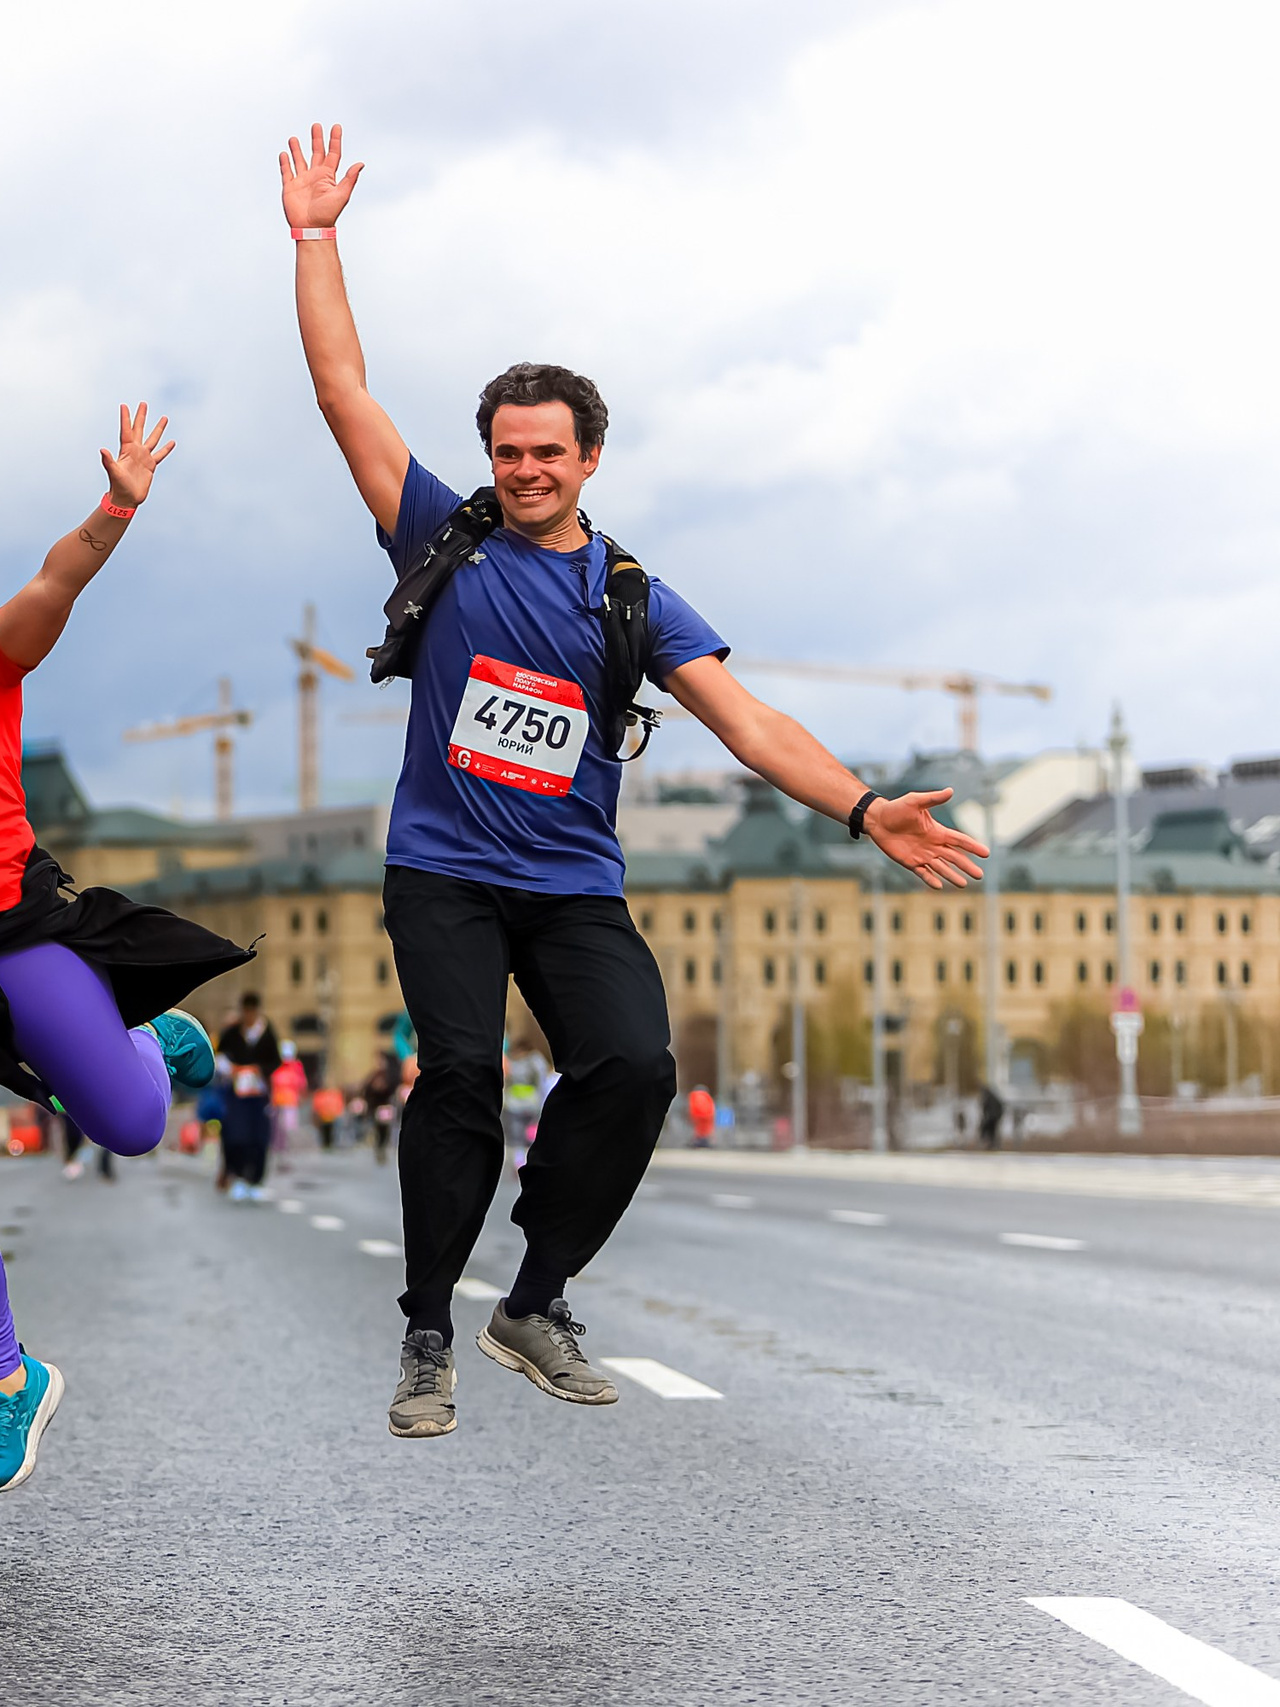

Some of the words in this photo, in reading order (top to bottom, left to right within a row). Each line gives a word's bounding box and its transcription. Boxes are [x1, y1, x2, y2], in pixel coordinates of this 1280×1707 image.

[107, 505, 128, 516] 5217
[516, 671, 558, 688] МОСКОВСКИЙ
[512, 682, 544, 695] МАРАФОН
[473, 695, 571, 749] 4750
[497, 737, 534, 755] ЮРИЙ
[458, 750, 472, 769] G
